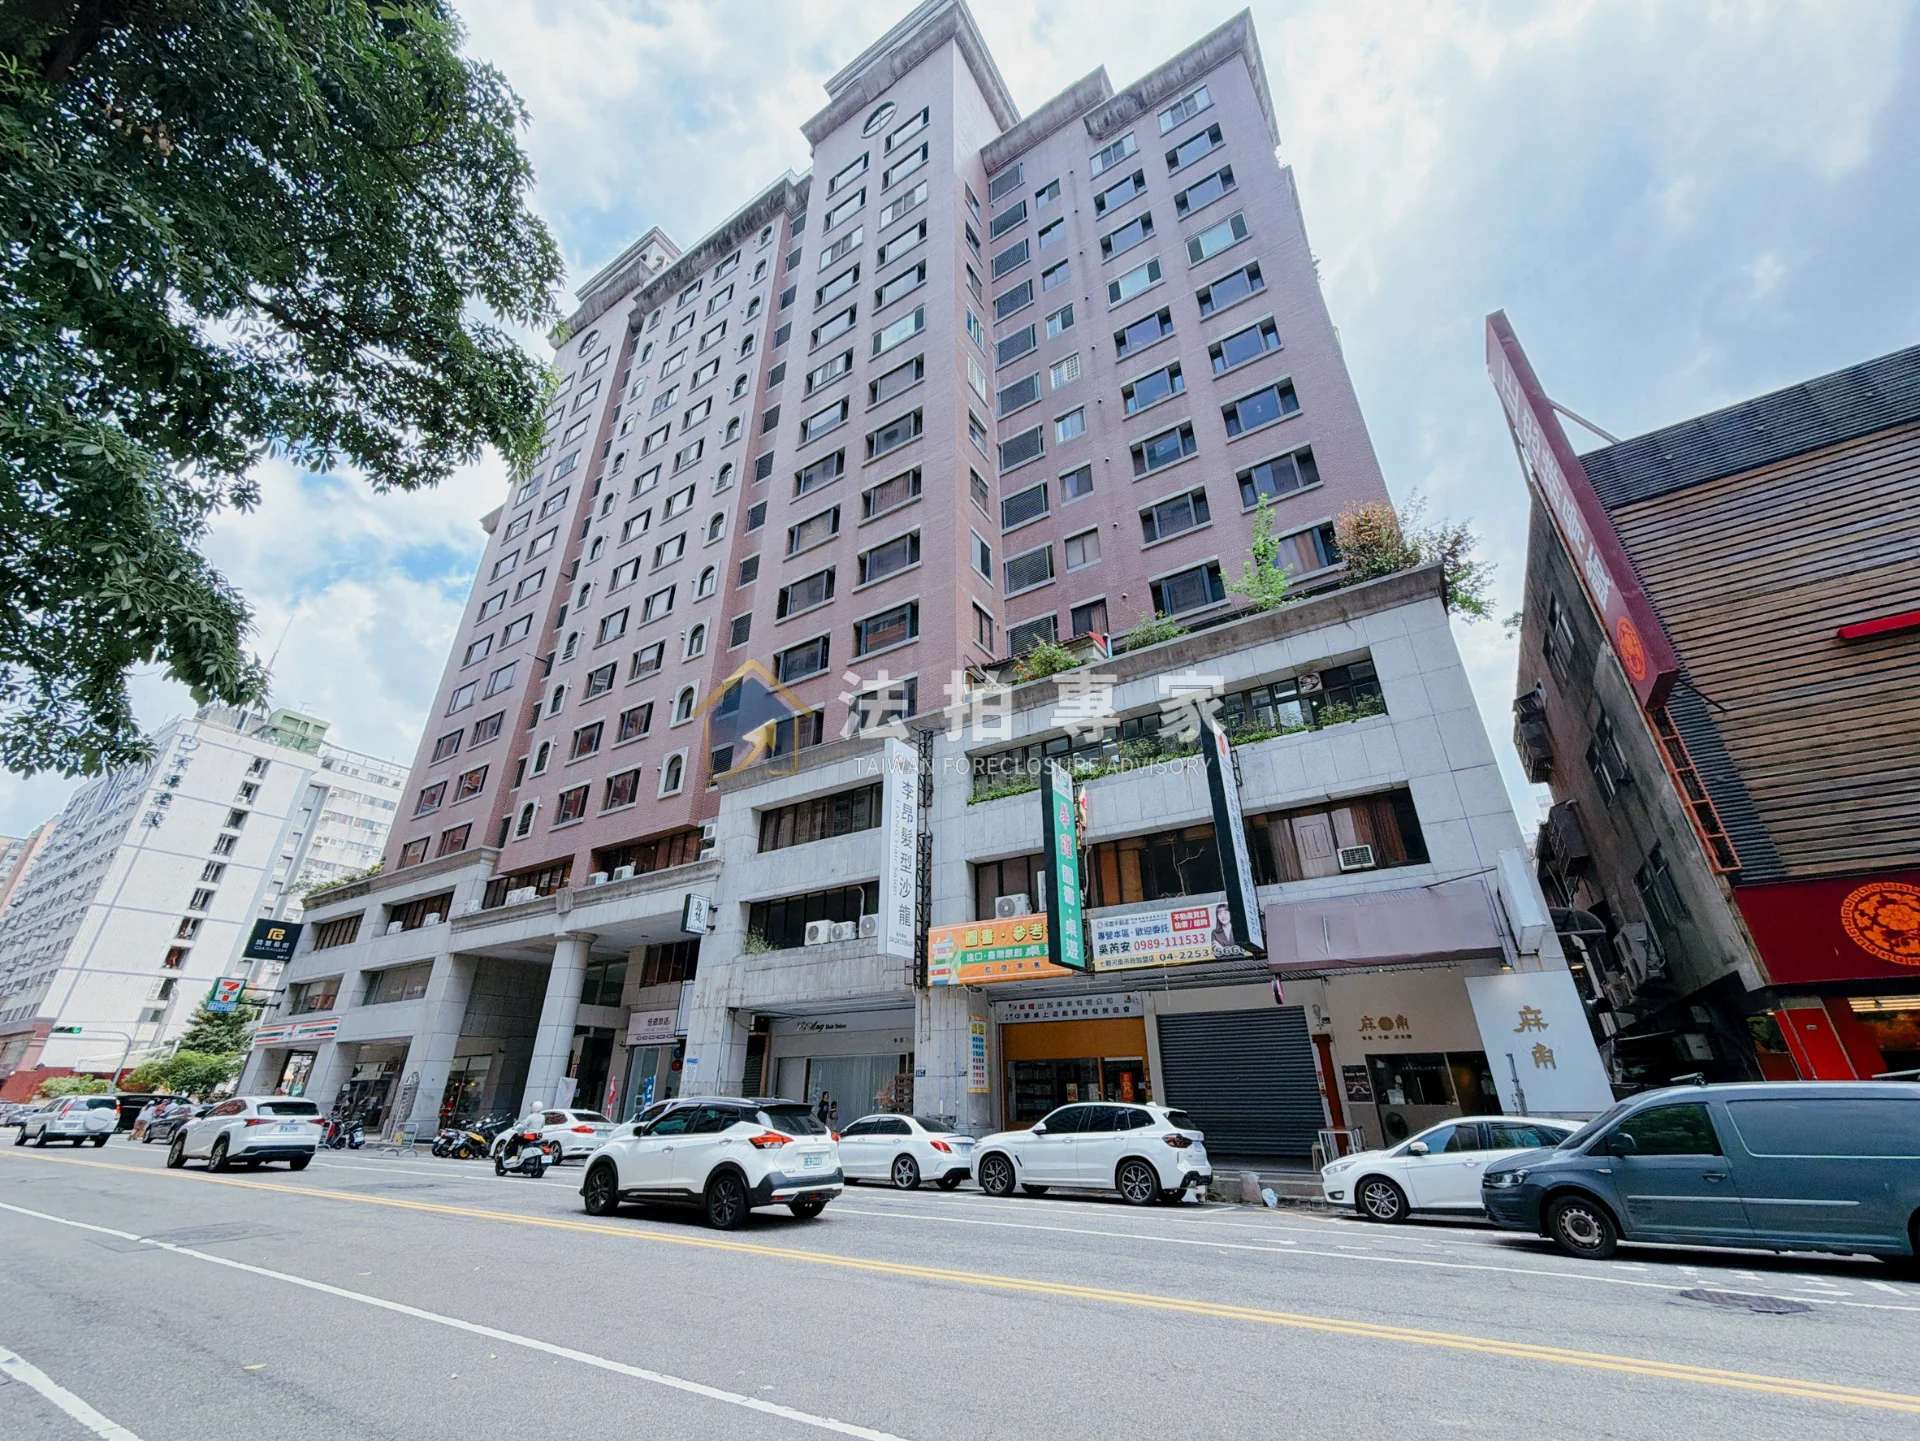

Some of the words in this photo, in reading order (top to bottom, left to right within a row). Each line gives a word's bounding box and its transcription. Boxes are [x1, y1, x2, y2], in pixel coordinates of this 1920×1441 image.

[1502, 359, 1610, 612] 正忠排骨飯
[898, 780, 914, 928] 李昂髮型沙龍
[1098, 941, 1131, 956] 吳芮安
[1133, 933, 1207, 951] 0989-111533
